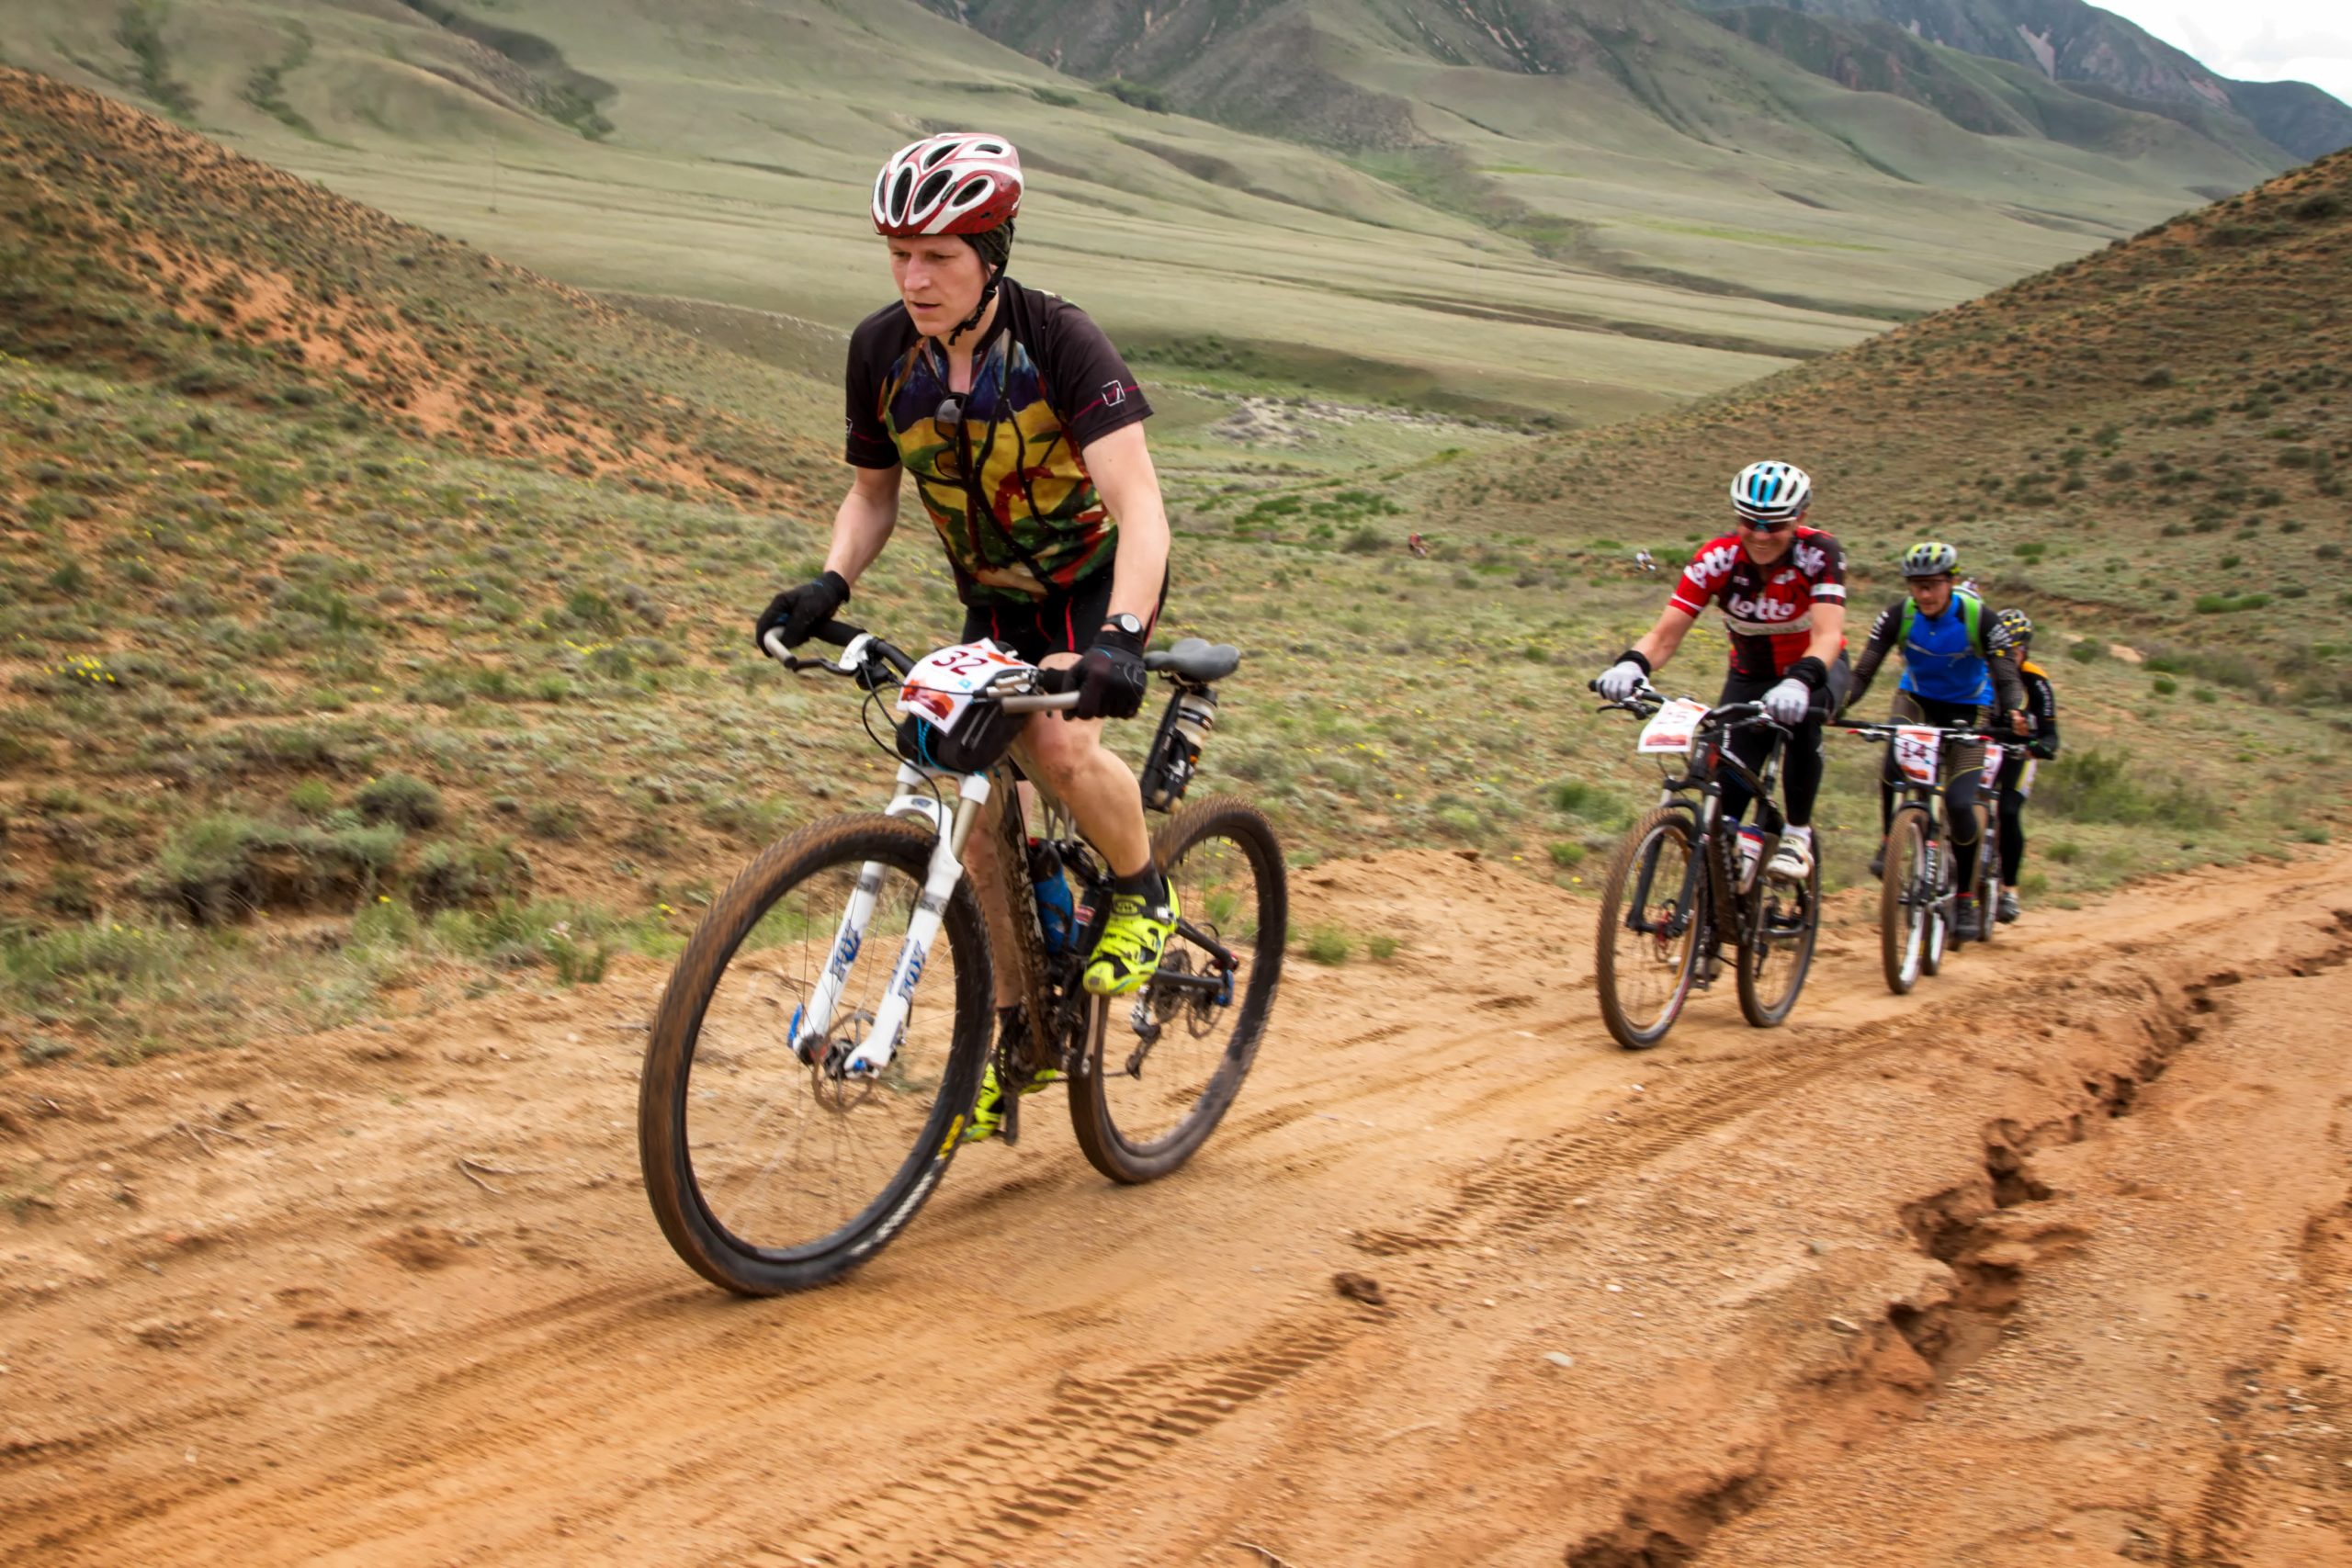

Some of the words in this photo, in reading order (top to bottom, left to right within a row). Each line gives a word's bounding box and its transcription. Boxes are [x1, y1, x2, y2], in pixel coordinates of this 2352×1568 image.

[932, 649, 989, 676] 32
[1901, 741, 1927, 759] 14
[898, 940, 927, 1002] FOX
